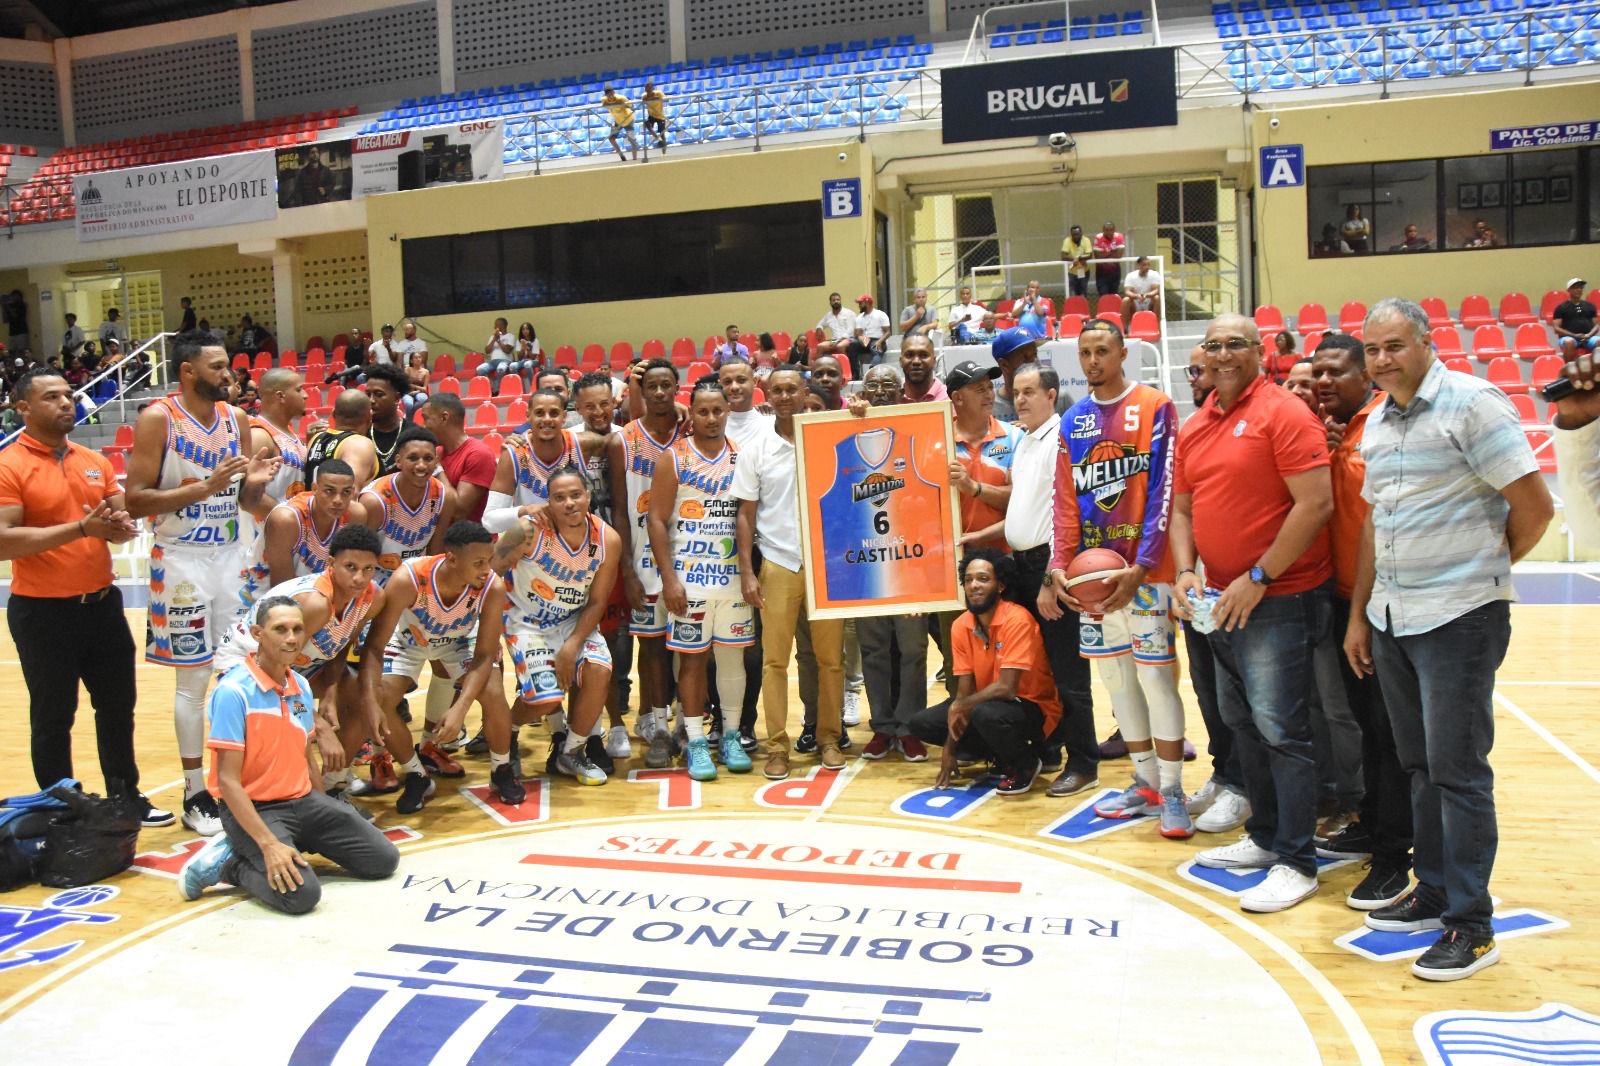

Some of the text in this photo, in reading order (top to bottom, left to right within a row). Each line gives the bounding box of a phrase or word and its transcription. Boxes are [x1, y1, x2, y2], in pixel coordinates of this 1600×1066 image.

[986, 81, 1105, 114] BRUGAL
[460, 120, 496, 133] GNC
[1499, 126, 1560, 141] PALCO
[1565, 123, 1591, 135] DE
[356, 132, 403, 150] MEGA MEN
[1512, 139, 1534, 147] Lic.
[124, 164, 220, 189] APOYANDO
[1268, 158, 1297, 185] A
[177, 178, 268, 207] EL DEPORTE
[831, 191, 854, 216] B
[82, 213, 195, 233] MINISTERIO ADMINISTRATIVO
[855, 479, 904, 501] MELLIZOS
[708, 510, 738, 518] hous
[873, 510, 890, 535] 6
[679, 541, 720, 556] JDL
[844, 543, 925, 565] CASTILLO
[673, 559, 741, 576] EMANUEL
[685, 573, 730, 587] BRITO
[598, 834, 963, 872] DEPORTES
[402, 872, 1121, 939] REPÚBLICA DOMINICANA
[424, 900, 1034, 968] GOBIERNO DE LA
